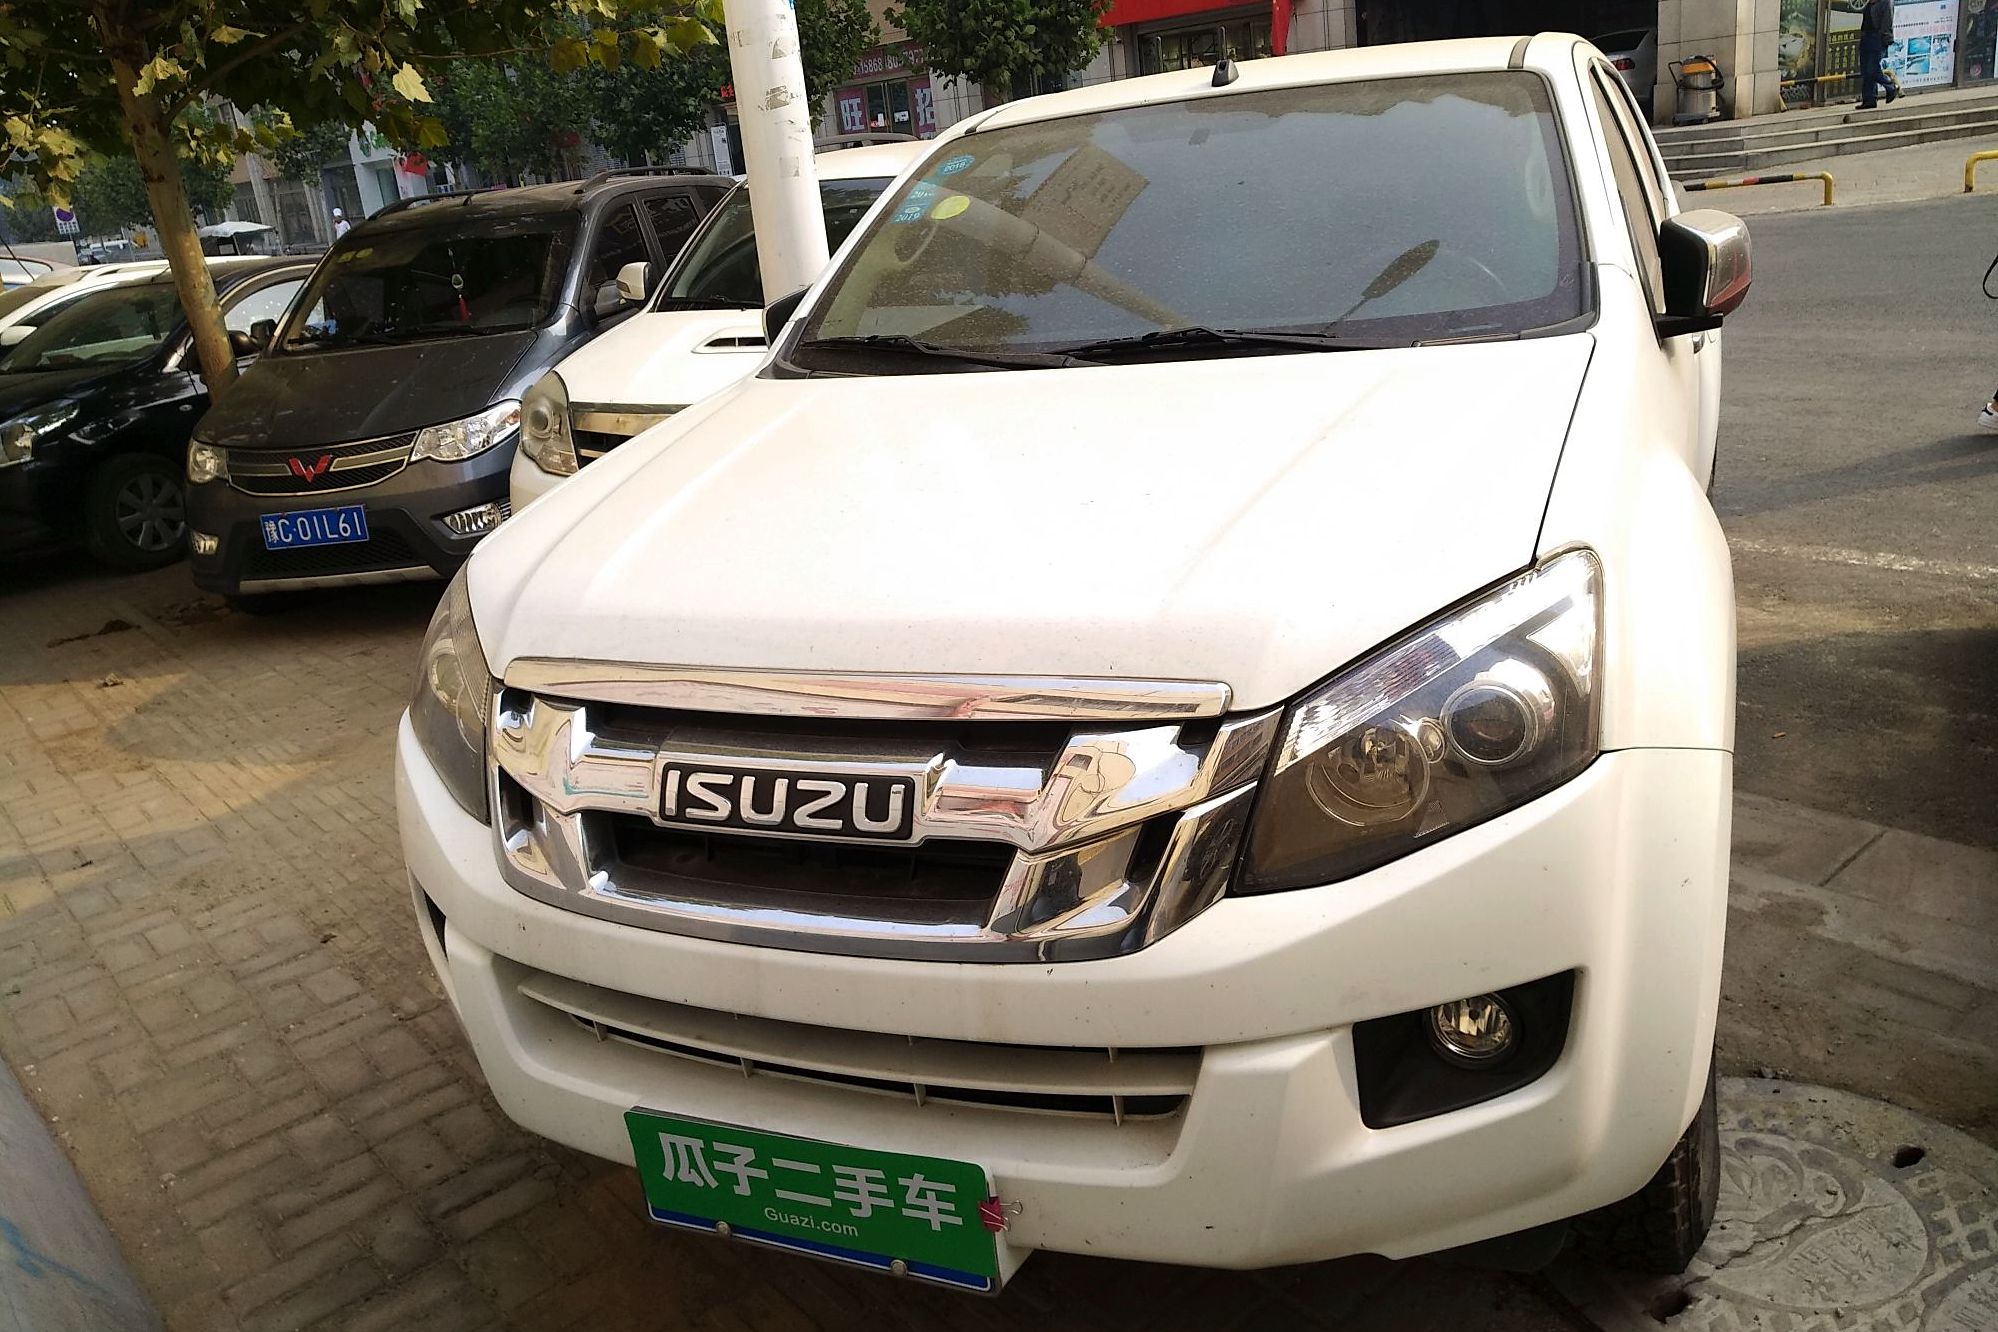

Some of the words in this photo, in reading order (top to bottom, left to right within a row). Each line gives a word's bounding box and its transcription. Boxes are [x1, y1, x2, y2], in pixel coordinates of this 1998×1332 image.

[664, 769, 906, 833] ISUZU
[658, 1132, 963, 1232] 瓜子二手车
[764, 1207, 859, 1237] Guazi.com
